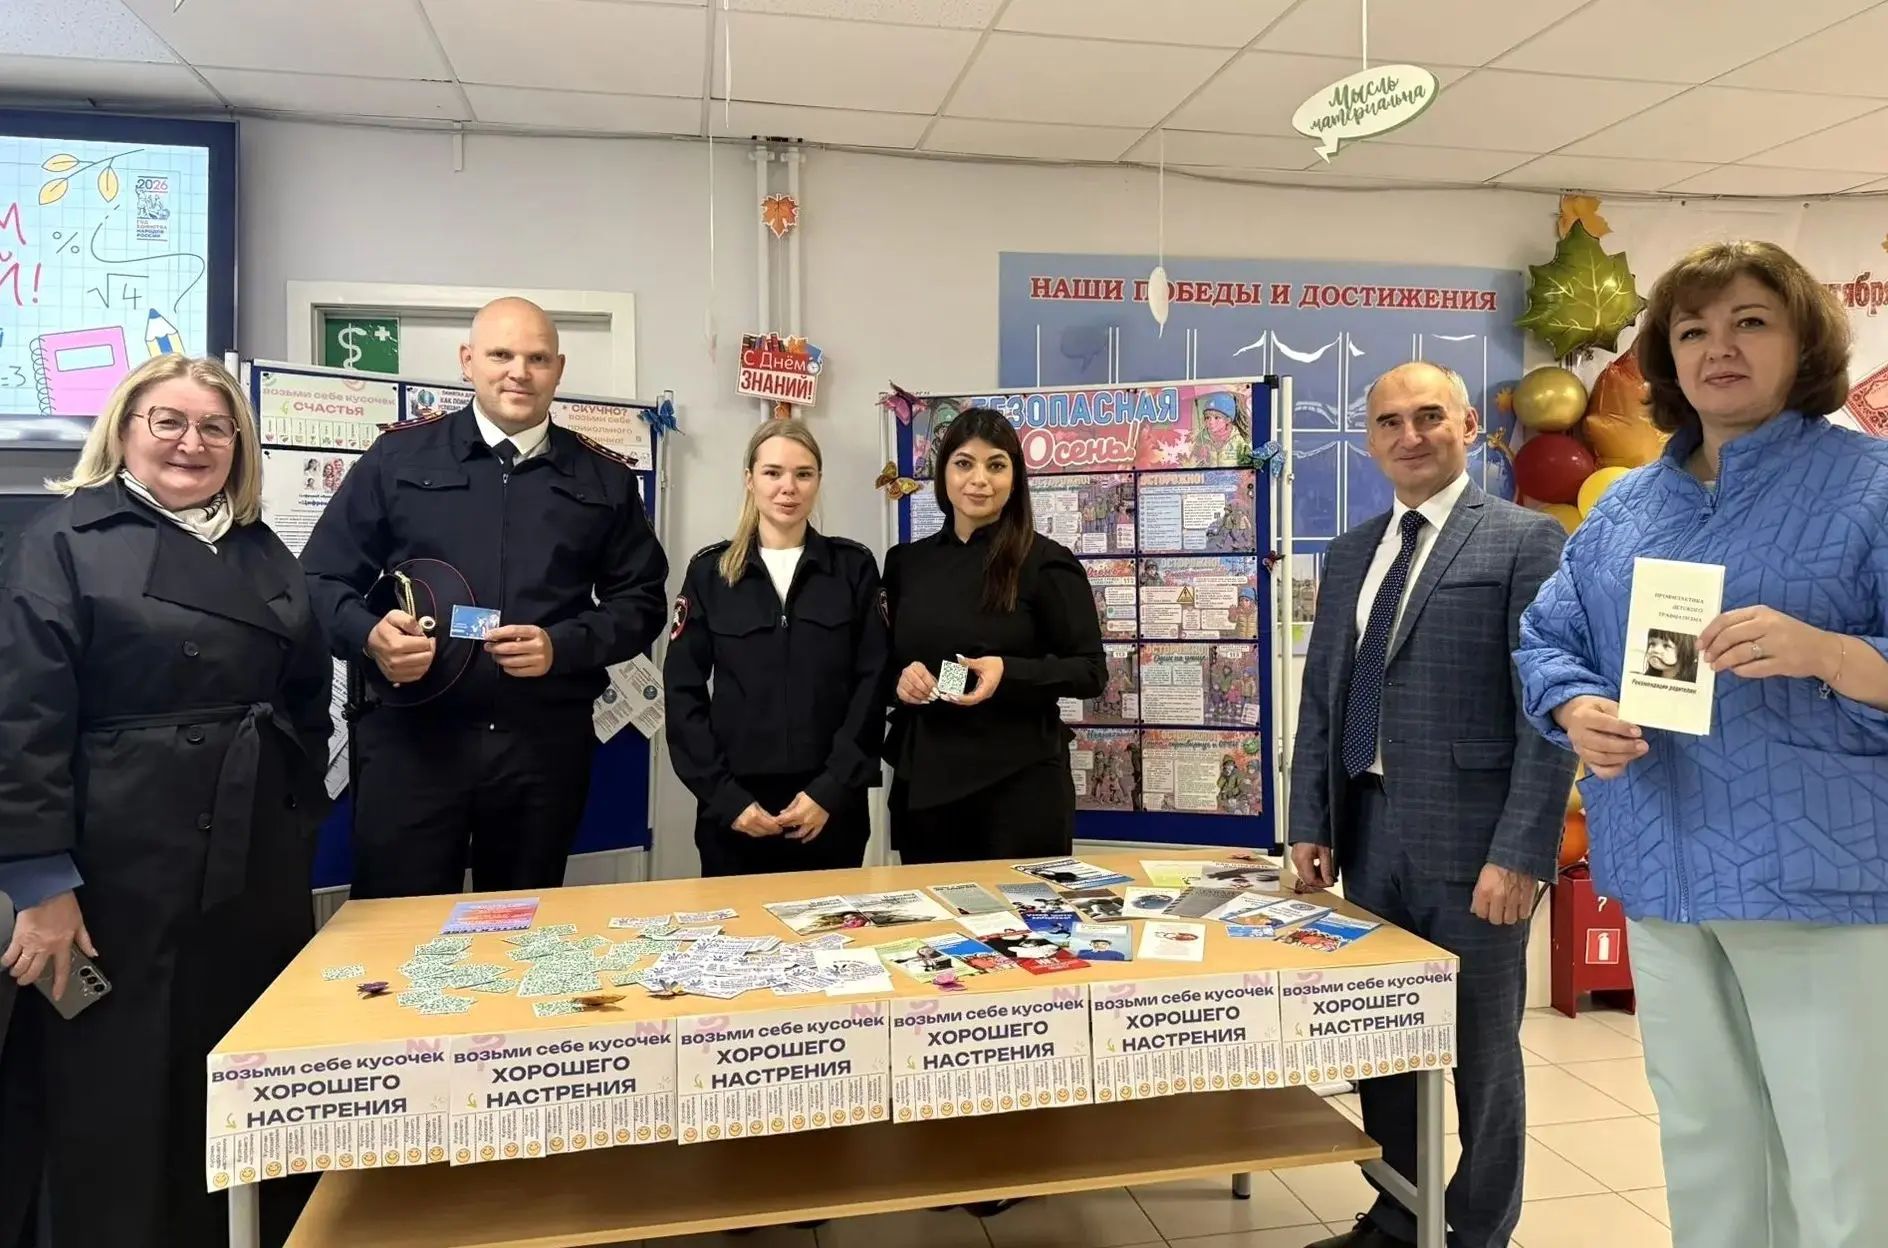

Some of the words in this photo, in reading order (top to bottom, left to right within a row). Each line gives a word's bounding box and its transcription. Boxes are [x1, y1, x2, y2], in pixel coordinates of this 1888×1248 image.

[1328, 76, 1399, 110] Мысль
[1310, 85, 1425, 132] материальна
[137, 178, 168, 190] 2026
[1030, 276, 1124, 301] НАШИ
[1270, 284, 1291, 304] И
[1298, 284, 1497, 310] ДОСТИЖЕНИЯ
[743, 349, 755, 366] С
[759, 351, 807, 372] Днём
[740, 370, 813, 400] ЗНАНИЙ!
[293, 401, 365, 416] СЧАСТЬЯ
[571, 404, 628, 416] СКУЧНО?
[1022, 418, 1139, 470] Осень!
[1094, 996, 1158, 1011] возьми
[1161, 990, 1201, 1004] себе
[1204, 986, 1274, 1003] кусочек
[1282, 981, 1344, 997] возьми
[1347, 977, 1385, 991] себе
[1387, 972, 1453, 989] кусочек
[894, 1011, 962, 1028] возьми
[966, 1005, 1008, 1021] себе
[1011, 999, 1084, 1017] кусочек
[1313, 992, 1420, 1015] ХОРОШЕГО
[681, 1028, 754, 1045] возьми
[758, 1022, 804, 1038] себе
[807, 1016, 884, 1035] кусочек
[1126, 1006, 1241, 1030] ХОРОШЕГО
[1309, 1011, 1425, 1037] НАСТРЕНИЯ
[927, 1020, 1049, 1047] ХОРОШЕГО
[1122, 1027, 1246, 1052] НАСТРЕНИЯ
[454, 1046, 532, 1064] возьми
[536, 1040, 585, 1056] себе
[588, 1033, 672, 1054] кусочек
[716, 1037, 846, 1065] ХОРОШЕГО
[923, 1042, 1055, 1070] НАСТРЕНИЯ
[212, 1066, 296, 1083] возьми
[300, 1057, 353, 1074] себе
[356, 1051, 444, 1071] кусочек
[492, 1056, 630, 1084] ХОРОШЕГО
[711, 1059, 851, 1090] НАСТРЕНИЯ
[253, 1074, 401, 1103] ХОРОШЕГО
[486, 1078, 636, 1109] НАСТРЕНИЯ
[247, 1097, 407, 1129] НАСТРЕНИЯ
